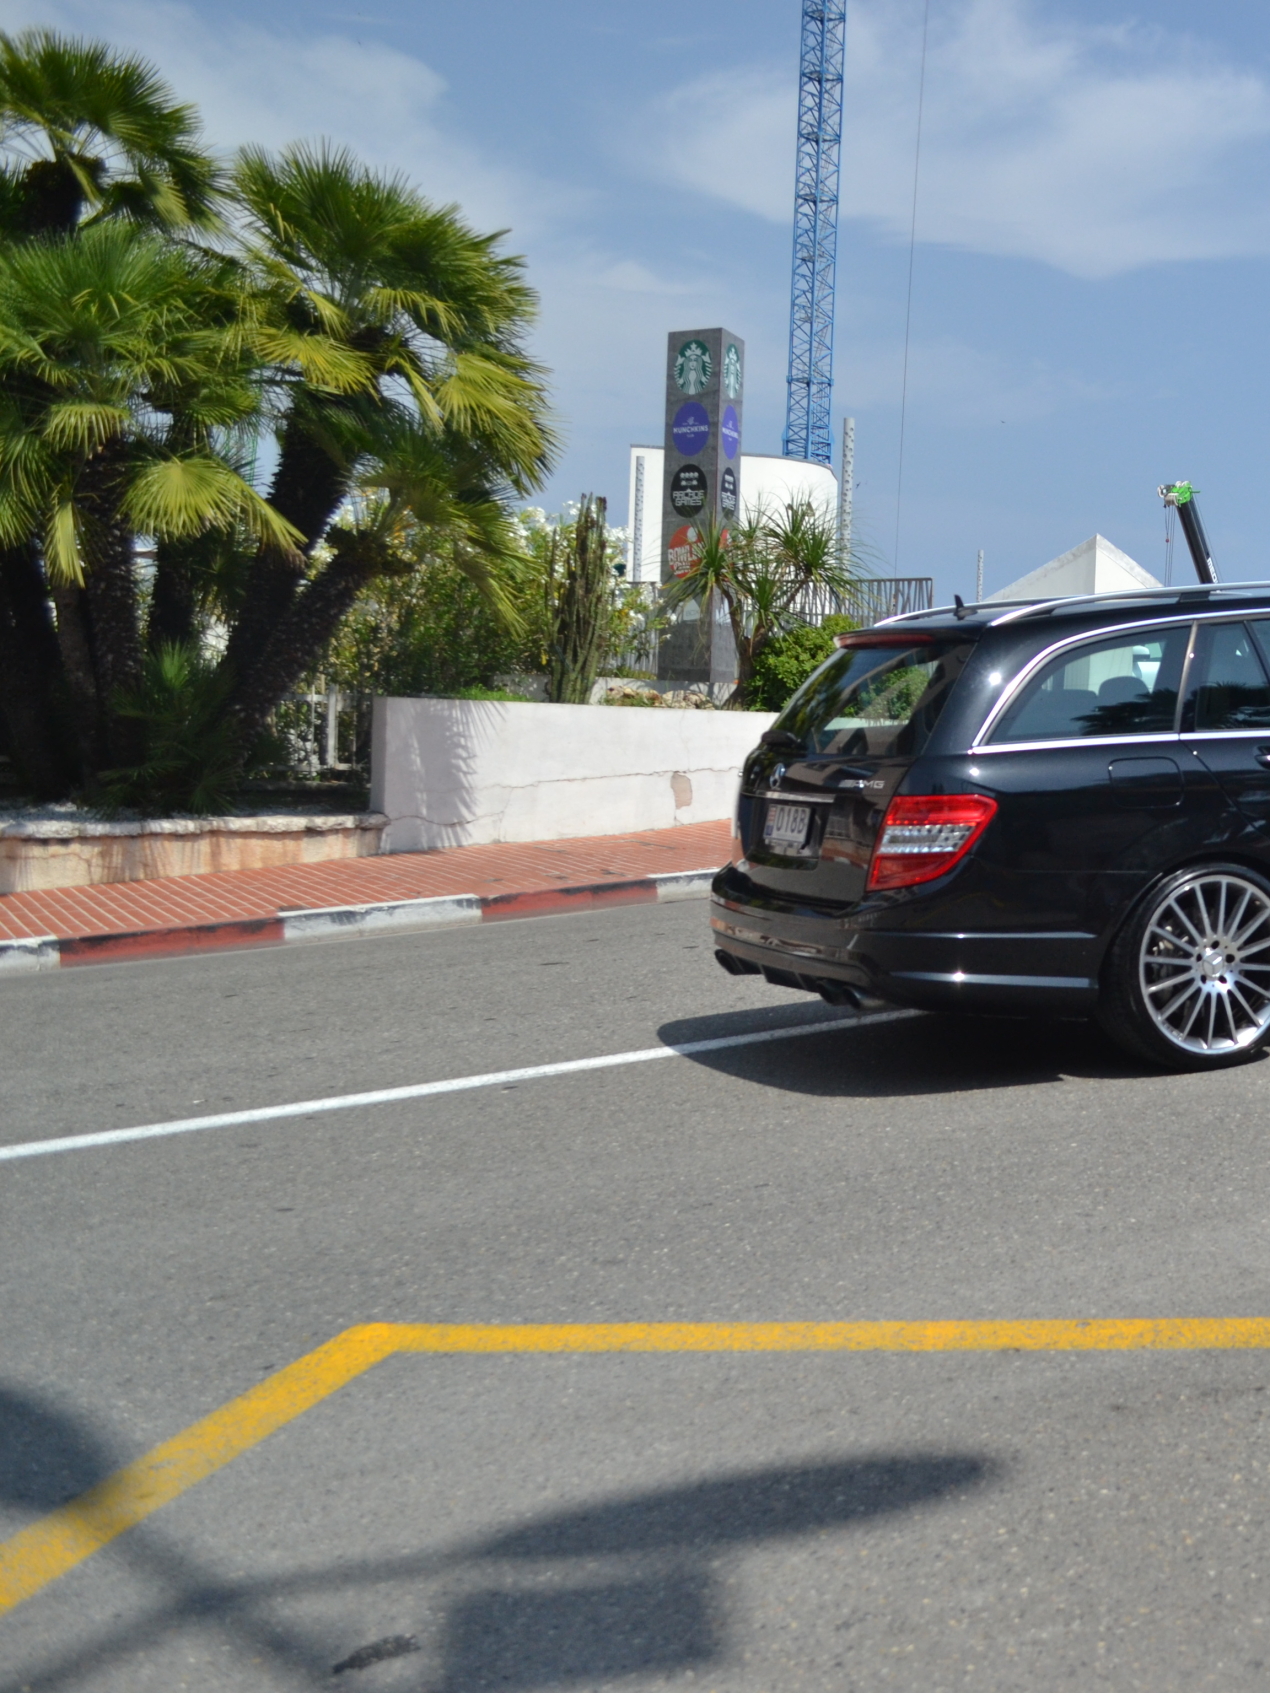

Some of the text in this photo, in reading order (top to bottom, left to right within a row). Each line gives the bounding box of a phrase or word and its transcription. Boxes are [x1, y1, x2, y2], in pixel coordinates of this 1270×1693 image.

[673, 424, 708, 434] MUNCHKINS
[673, 489, 705, 499] ARCADE
[675, 499, 702, 507] GAMES
[852, 780, 885, 789] AMG
